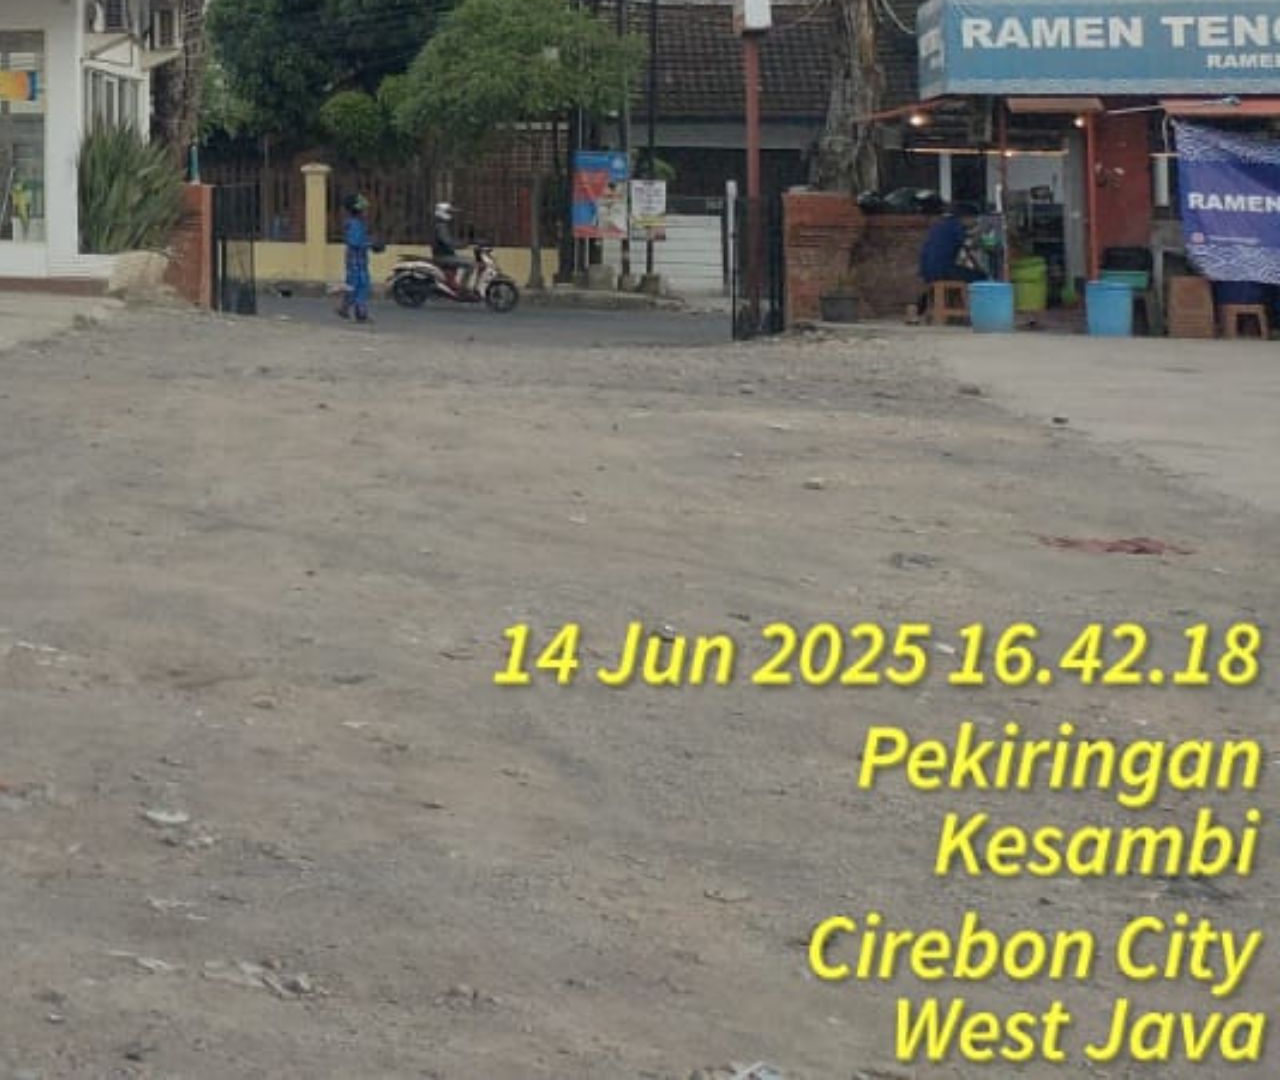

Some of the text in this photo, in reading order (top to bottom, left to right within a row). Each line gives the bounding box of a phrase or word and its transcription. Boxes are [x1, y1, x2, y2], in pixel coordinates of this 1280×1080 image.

[962, 17, 1280, 48] RAMEN TEN
[1206, 55, 1280, 69] RAME
